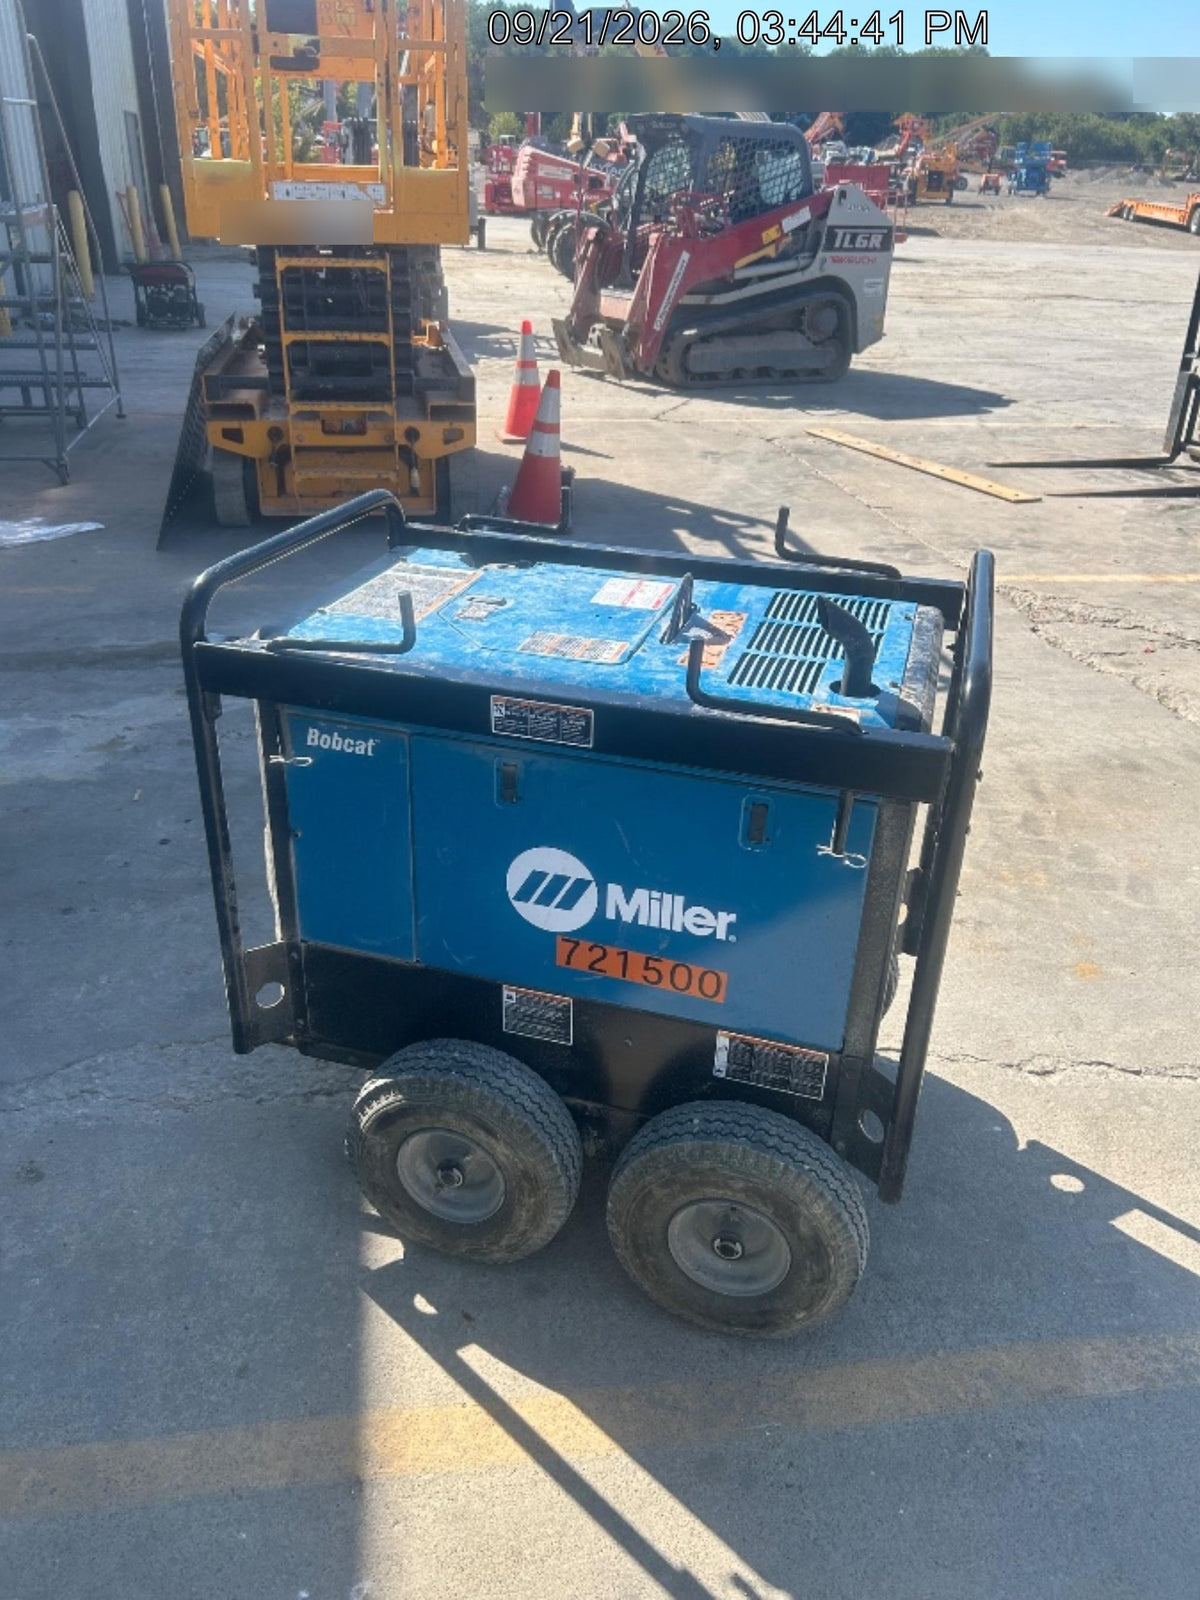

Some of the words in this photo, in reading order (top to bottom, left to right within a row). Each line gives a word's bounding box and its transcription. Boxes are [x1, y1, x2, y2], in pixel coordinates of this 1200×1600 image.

[306, 726, 377, 756] Bobcat
[605, 882, 737, 941] Miller
[561, 938, 723, 999] 721500
